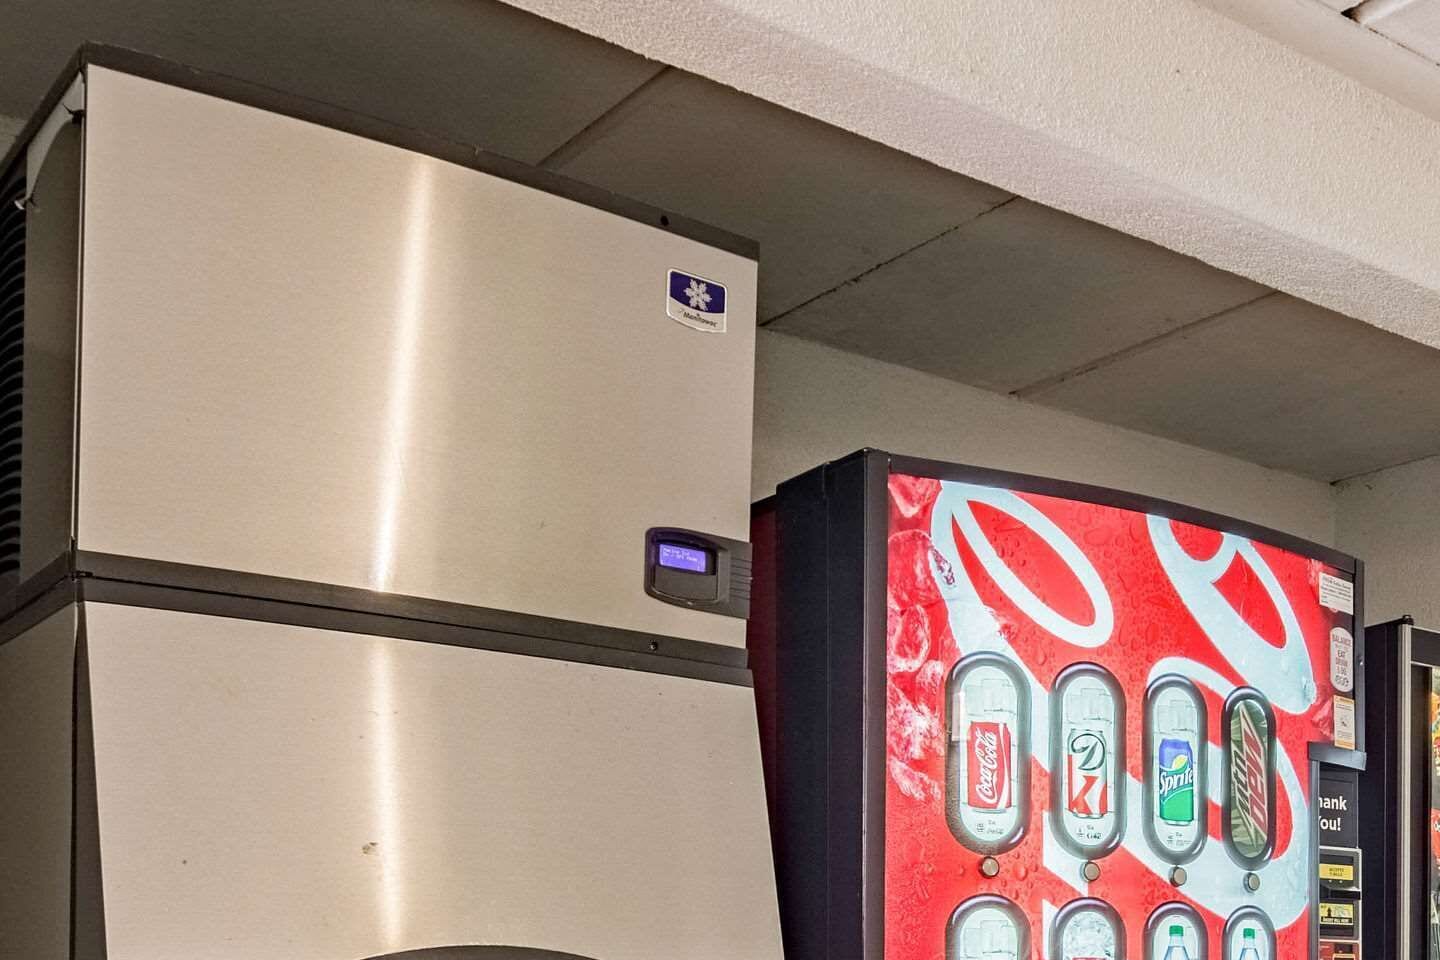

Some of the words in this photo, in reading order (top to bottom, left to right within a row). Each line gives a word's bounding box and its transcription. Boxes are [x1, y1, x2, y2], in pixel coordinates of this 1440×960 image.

[1160, 766, 1194, 794] Sprite
[1319, 796, 1347, 810] ank
[1319, 816, 1341, 831] ou!
